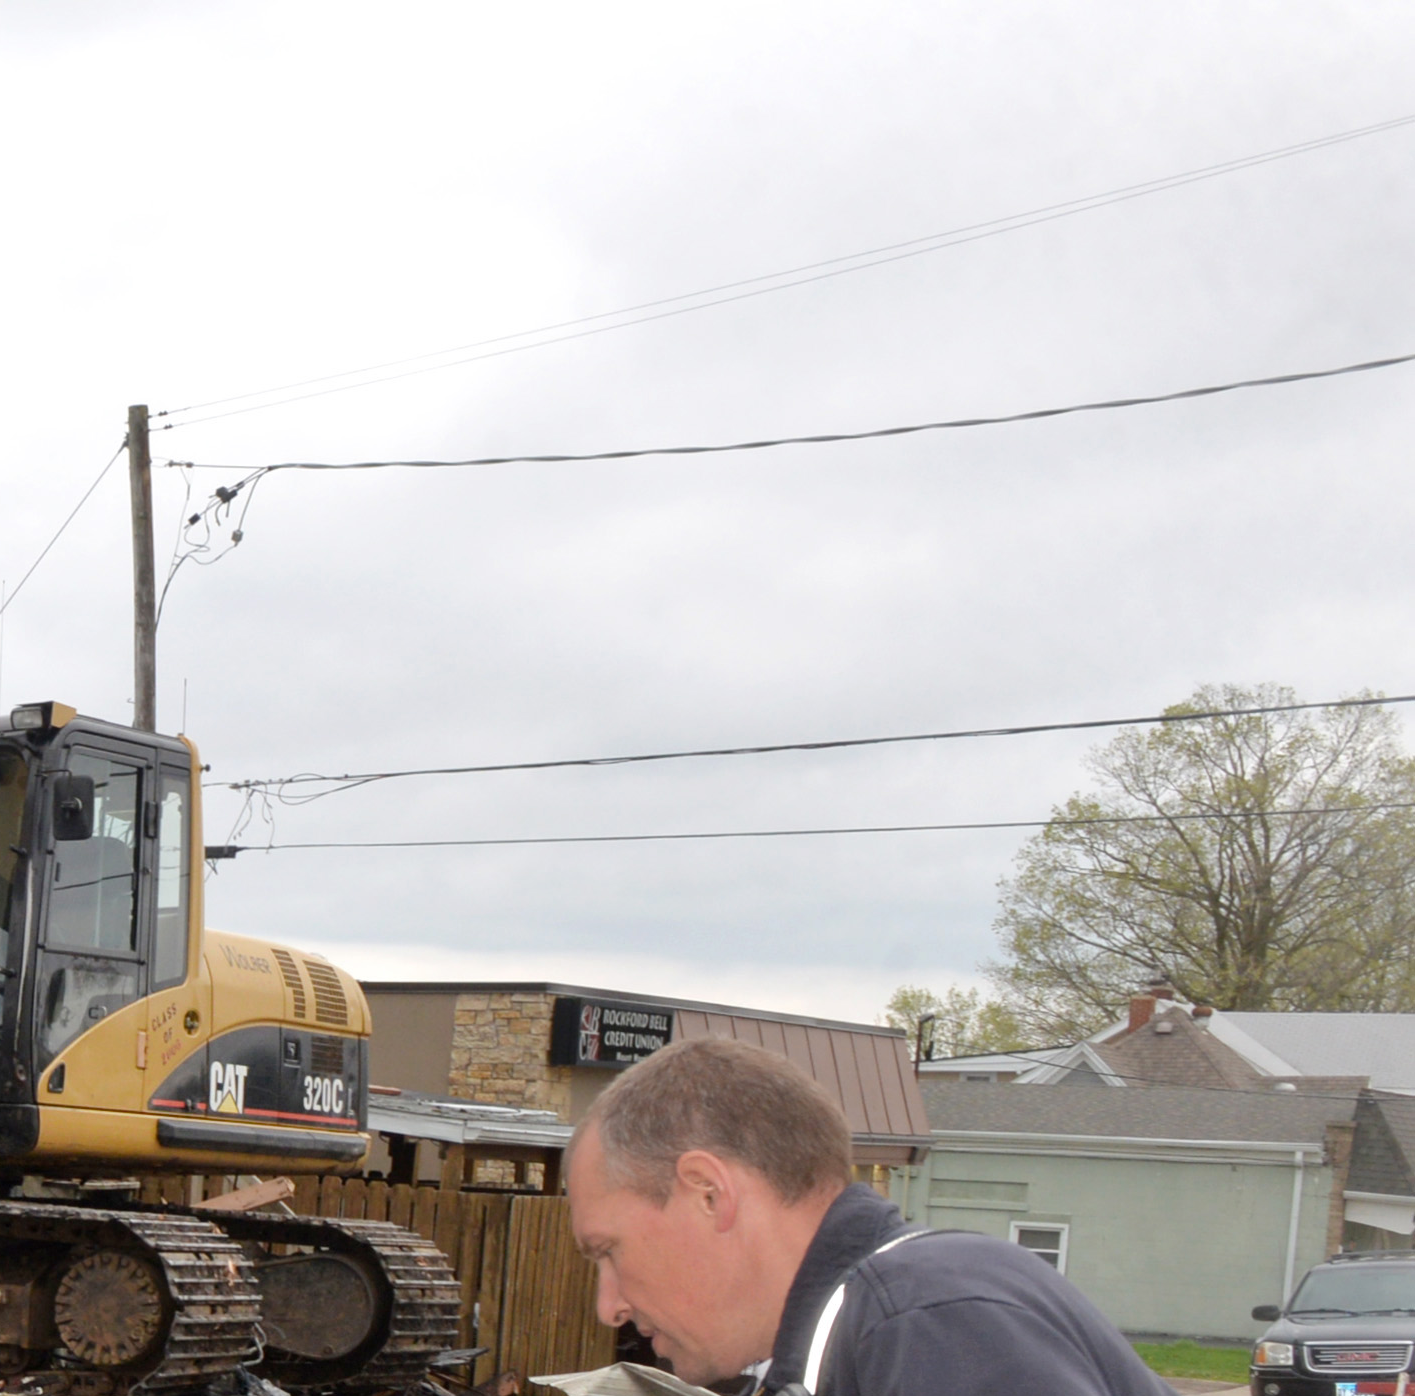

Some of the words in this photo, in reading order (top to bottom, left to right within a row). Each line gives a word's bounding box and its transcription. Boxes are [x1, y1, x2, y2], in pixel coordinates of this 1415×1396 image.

[603, 1009, 649, 1028] ROCKFORD
[649, 1015, 668, 1031] BELL
[604, 1031, 634, 1047] CREDIT
[635, 1034, 664, 1051] UNION
[209, 1061, 249, 1114] CAT
[303, 1075, 344, 1114] 320C
